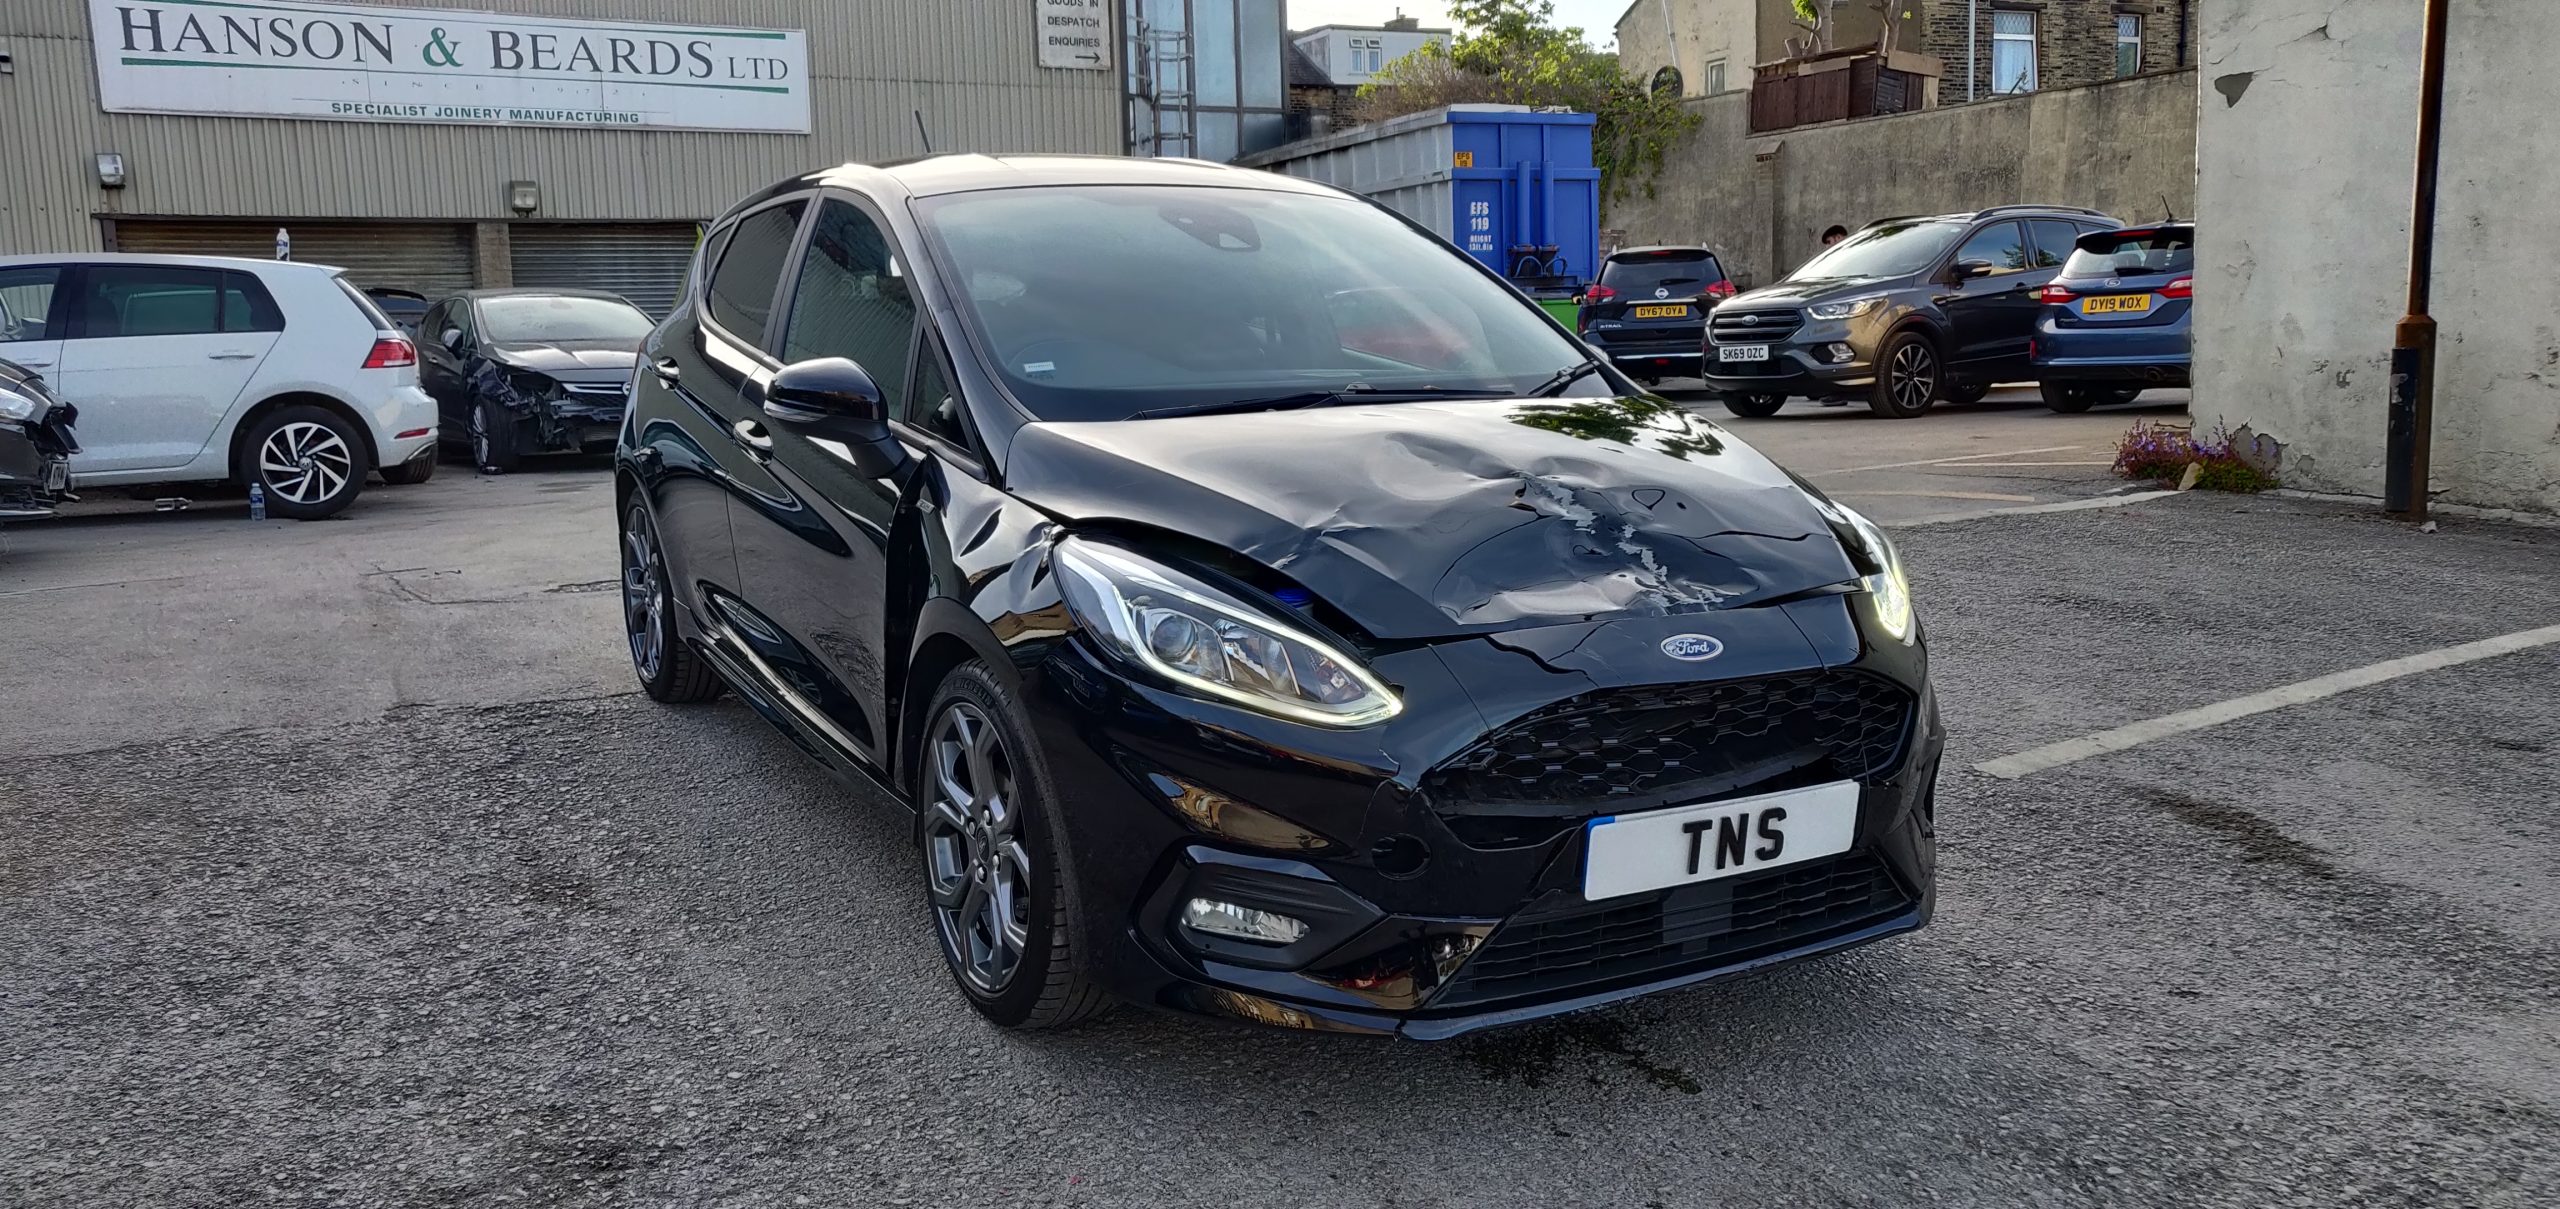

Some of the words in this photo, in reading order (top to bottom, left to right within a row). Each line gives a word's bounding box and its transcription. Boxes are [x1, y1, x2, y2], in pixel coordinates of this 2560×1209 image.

[1047, 16, 1100, 28] DESPATCH
[115, 6, 394, 65] HANSON
[422, 27, 464, 68] &
[486, 29, 714, 79] BEARDS
[728, 56, 789, 81] LTD
[1048, 36, 1100, 47] ENQUIRIES
[331, 102, 428, 118] SPECIALIST
[434, 106, 502, 120] JOINERY
[509, 109, 640, 124] MANUFACTURING
[1470, 202, 1489, 216] EFS
[1471, 217, 1489, 231] 119
[1640, 306, 1663, 316] DY67
[1665, 305, 1683, 315] OYA
[2090, 299, 2116, 310] DY19
[2119, 297, 2143, 309] WOX
[1723, 349, 1745, 360] SK69
[1746, 348, 1764, 359] OZC
[1676, 638, 1710, 655] Ford
[1682, 807, 1788, 875] TNS
